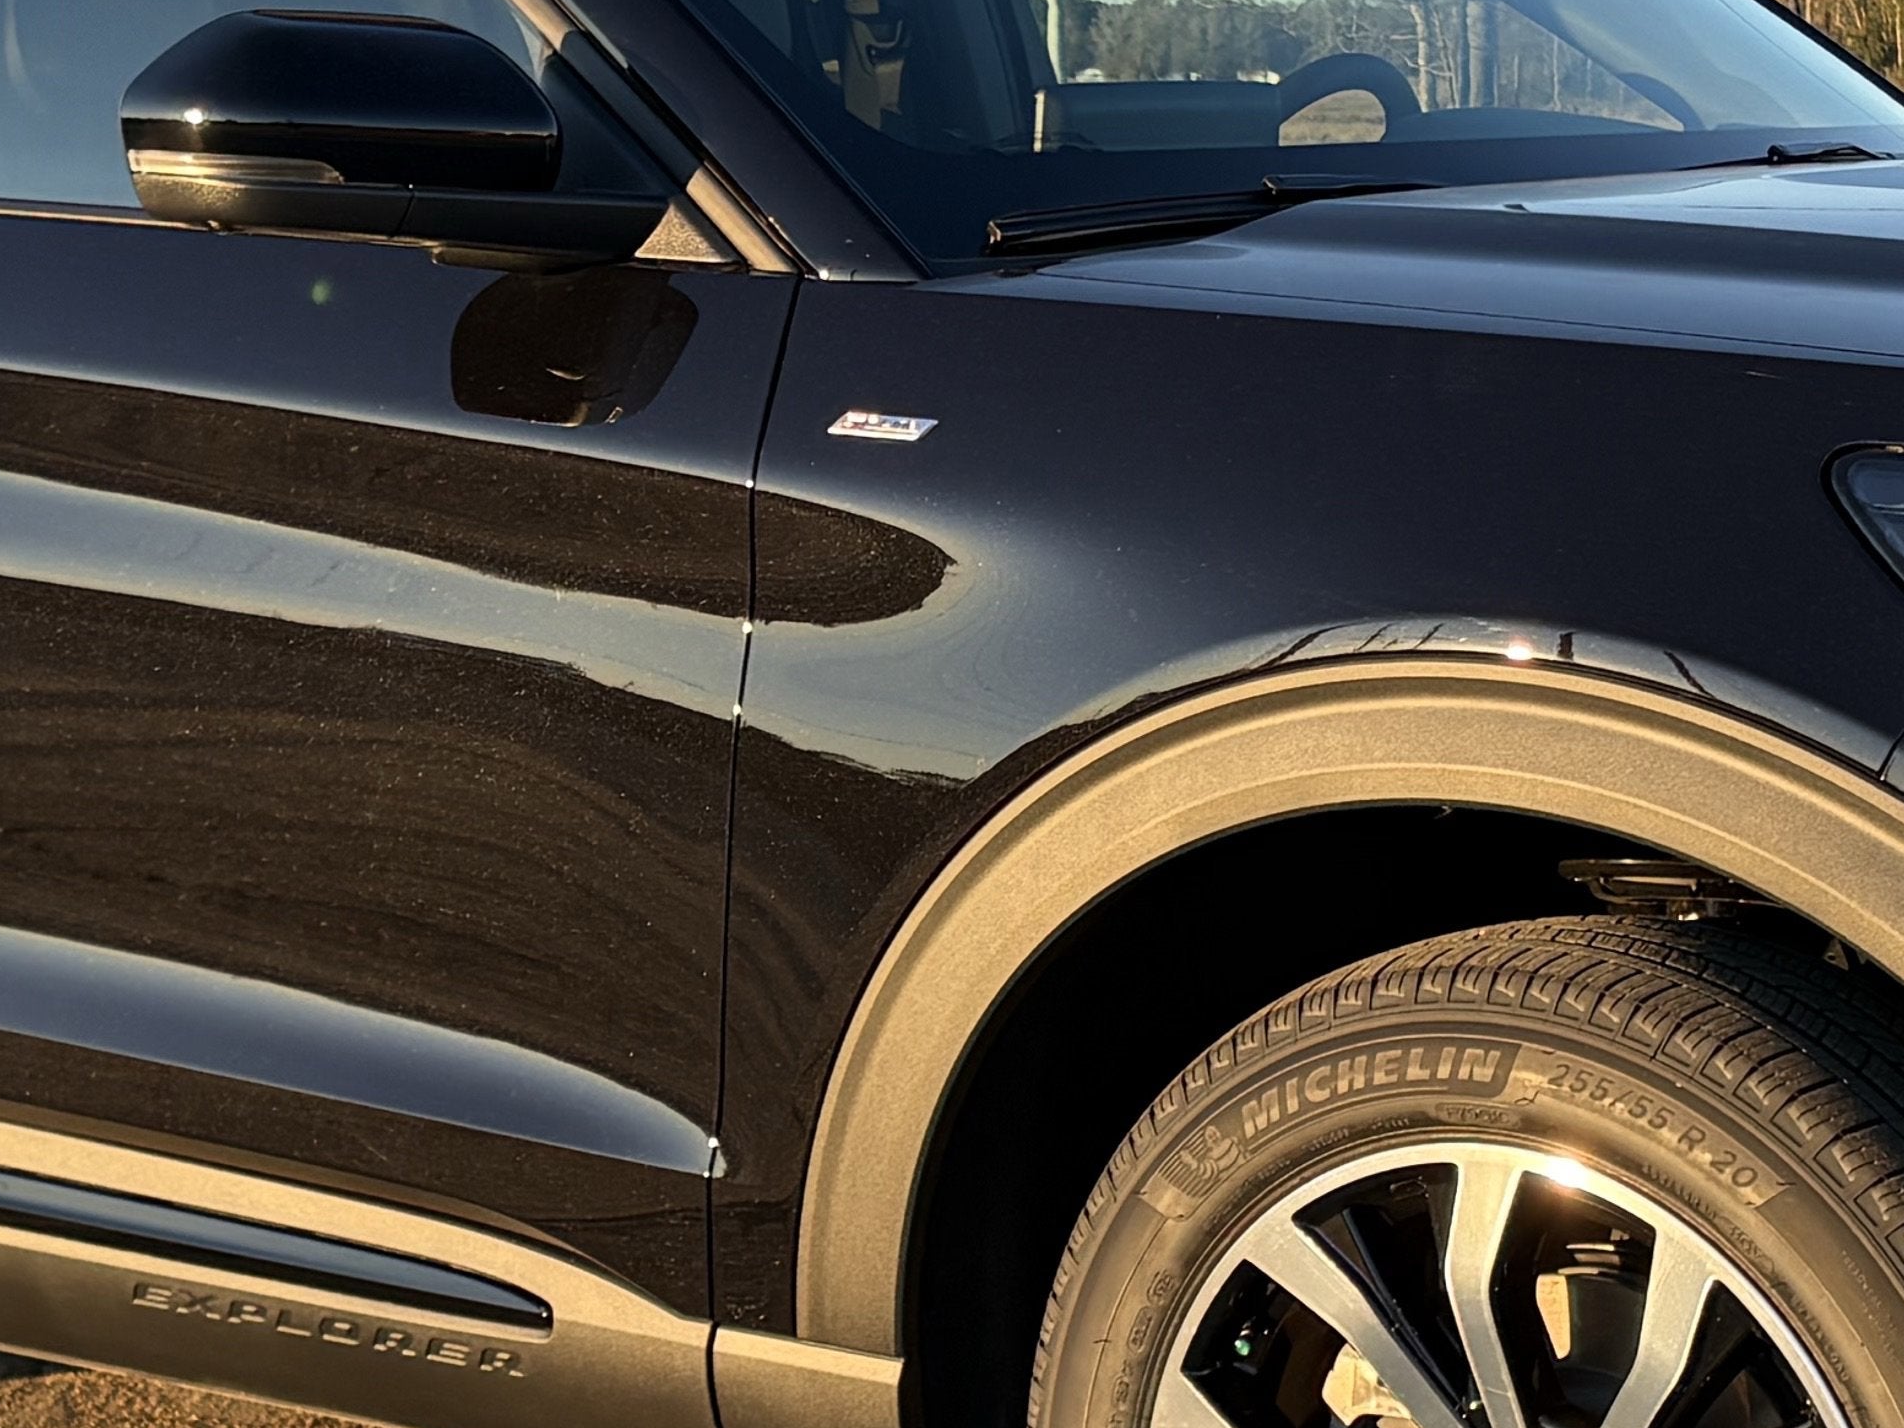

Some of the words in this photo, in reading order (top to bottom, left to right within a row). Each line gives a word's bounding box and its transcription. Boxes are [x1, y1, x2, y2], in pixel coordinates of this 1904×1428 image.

[1240, 1046, 1502, 1141] MICHELIN
[1546, 1063, 1675, 1130] 255/55
[1677, 1125, 1707, 1152] R
[1708, 1149, 1759, 1189] 20
[131, 1282, 526, 1378] EXPLORER
